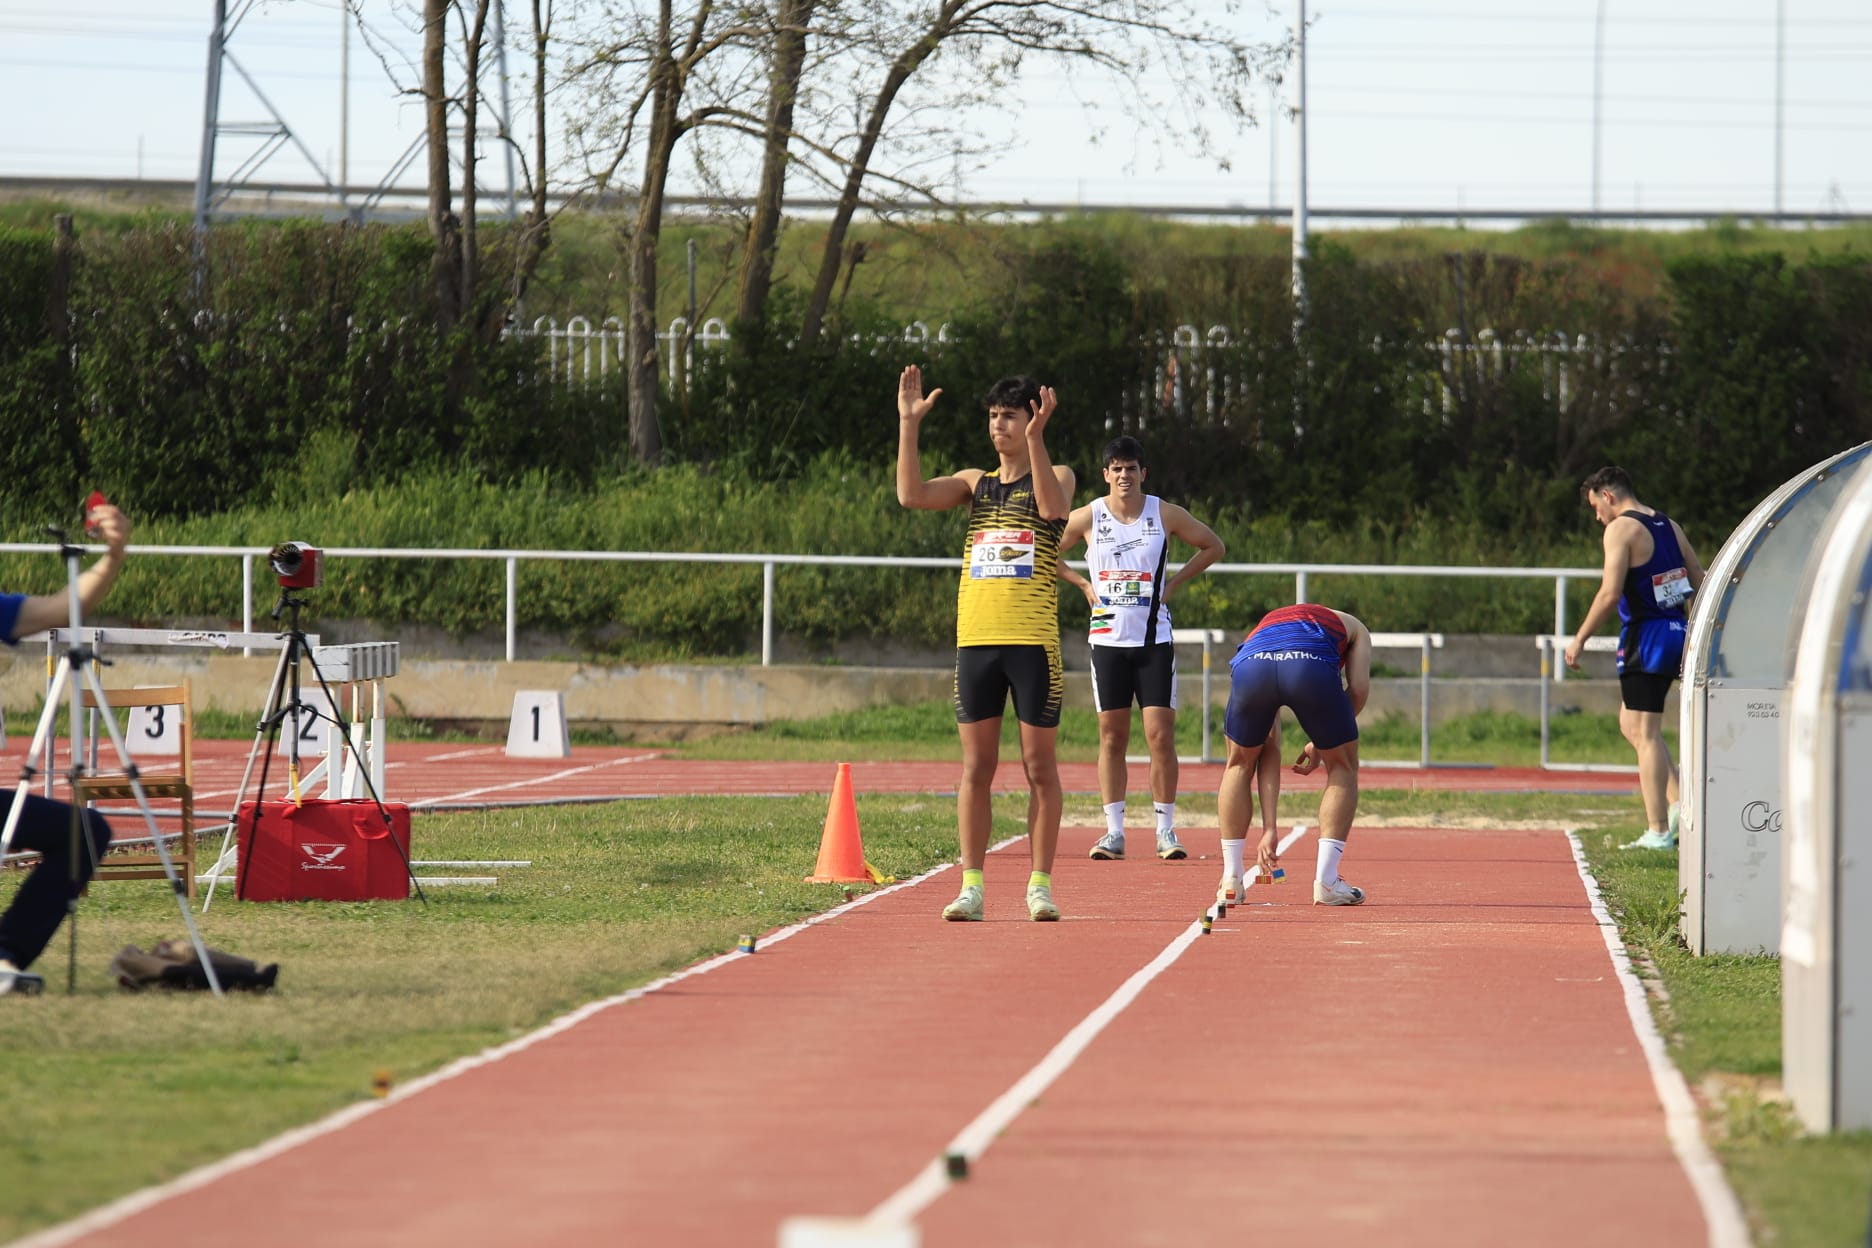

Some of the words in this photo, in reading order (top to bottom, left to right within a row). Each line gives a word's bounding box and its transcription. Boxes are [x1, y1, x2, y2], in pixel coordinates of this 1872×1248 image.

[980, 547, 996, 562] 26
[1107, 582, 1122, 595] 16
[1253, 651, 1326, 662] MARATHO
[144, 704, 165, 738] 3
[298, 704, 319, 741] 2
[531, 705, 540, 743] 1
